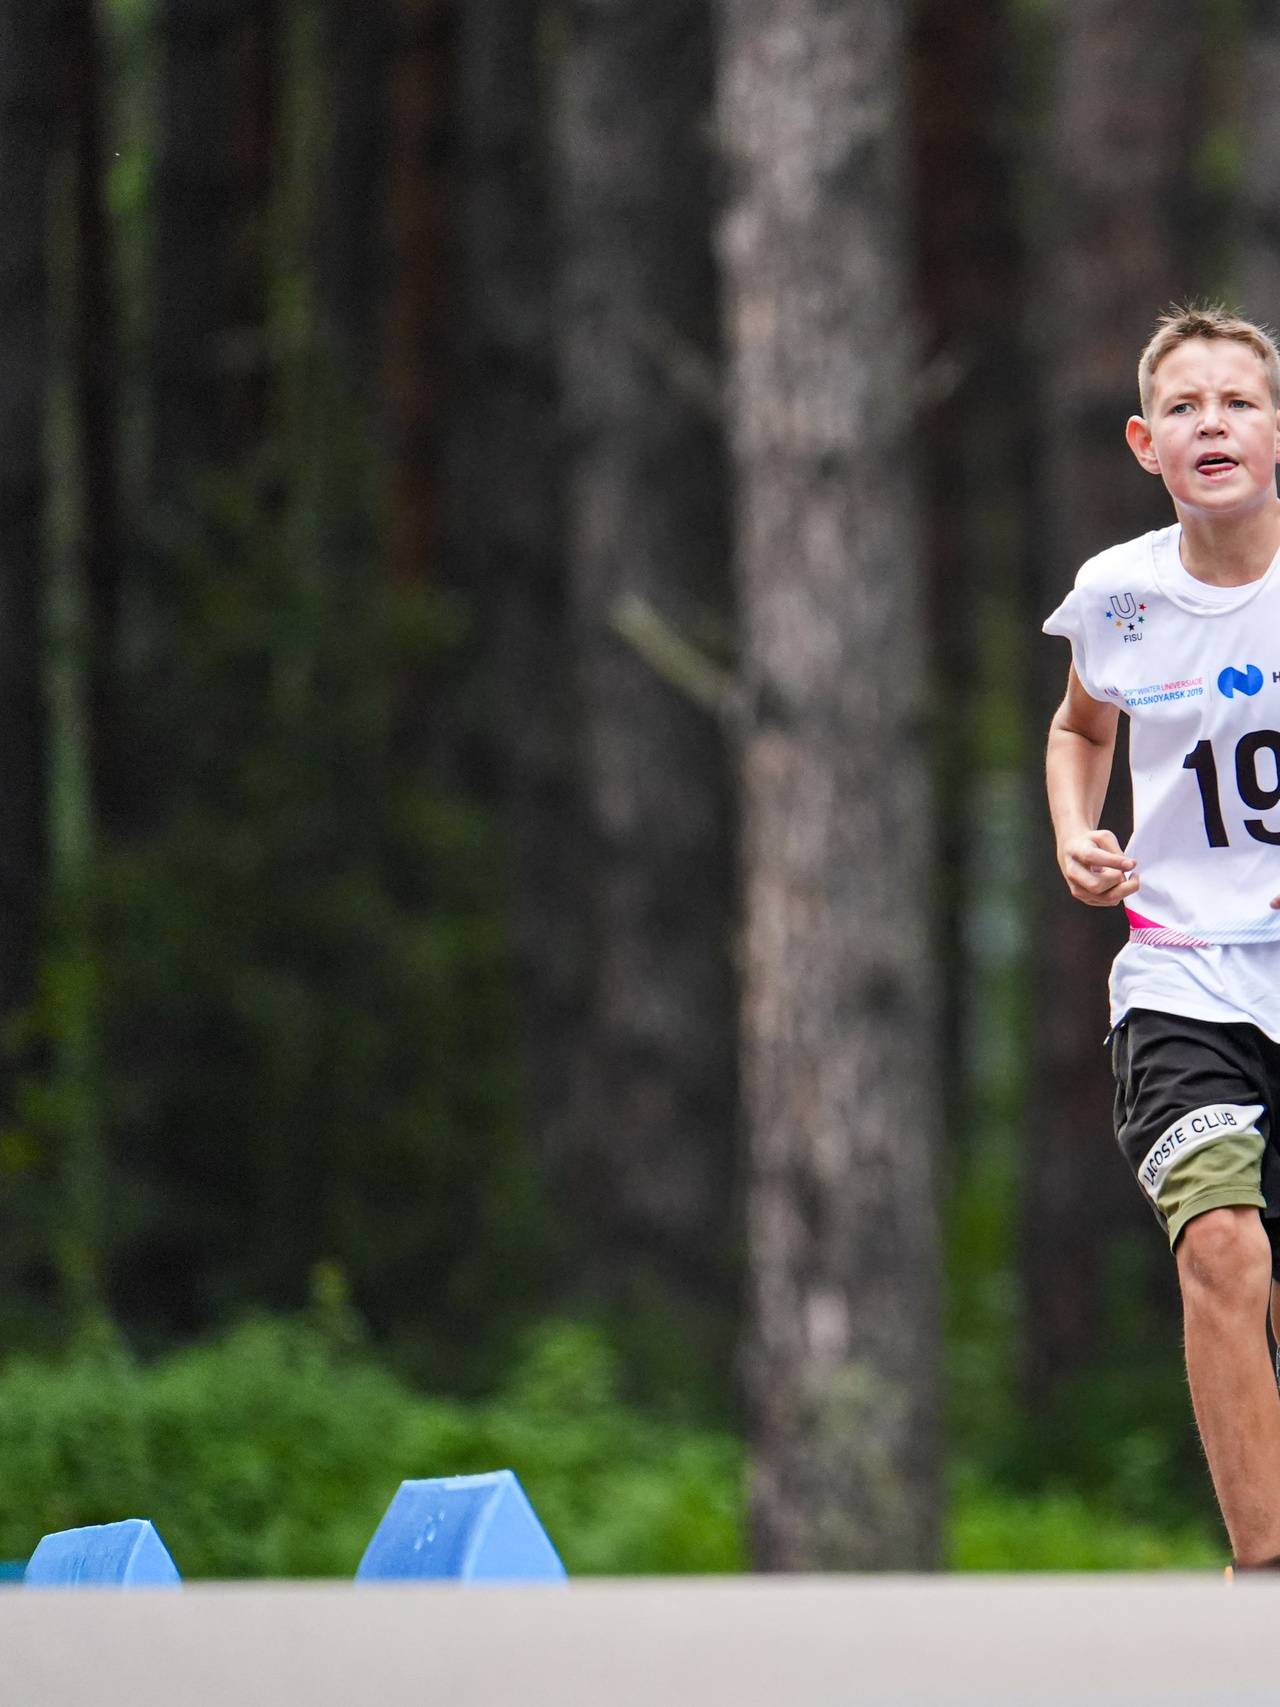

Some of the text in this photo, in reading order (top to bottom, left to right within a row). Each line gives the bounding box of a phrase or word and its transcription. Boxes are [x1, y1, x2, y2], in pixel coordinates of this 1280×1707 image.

[1124, 633, 1142, 643] FISU
[1138, 685, 1161, 695] WINTER
[1161, 677, 1203, 691] UNIVERSIADE
[1125, 687, 1203, 706] KRASNOYARSK 2019
[1144, 1113, 1237, 1186] LACOSTE CLUB
